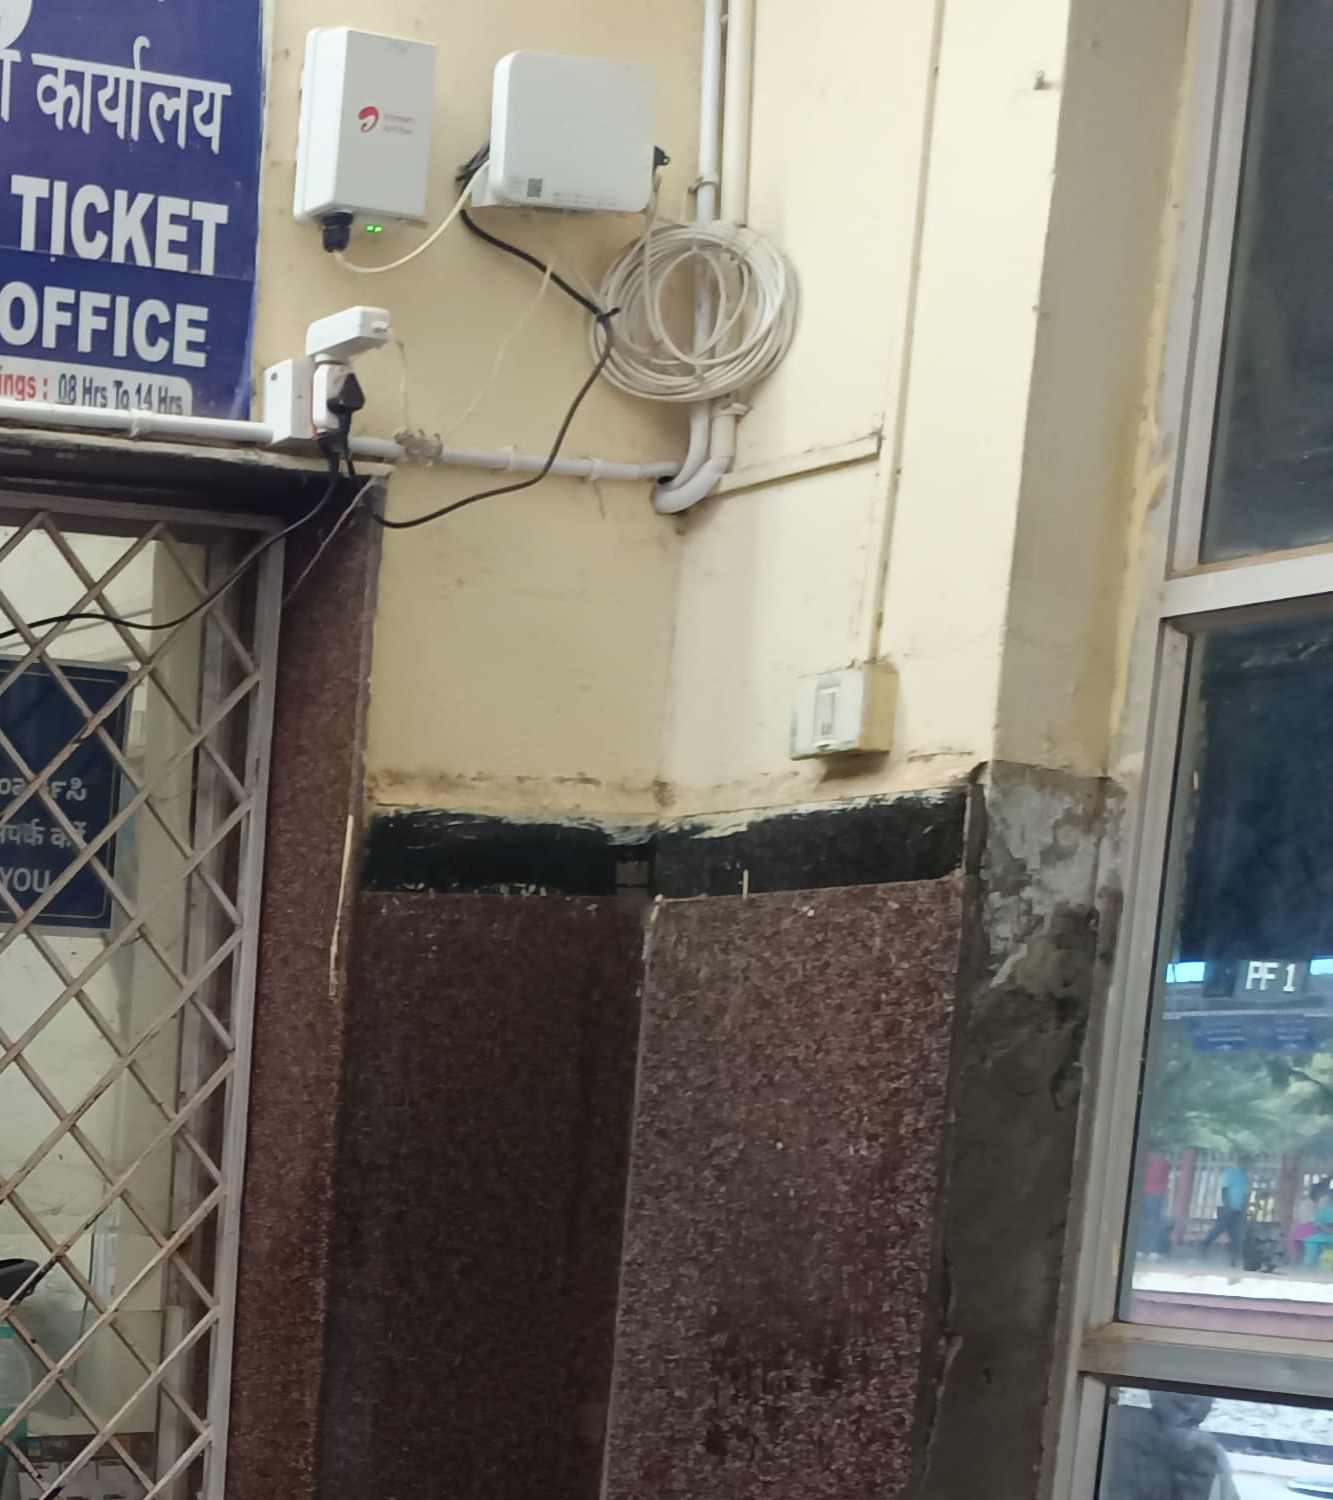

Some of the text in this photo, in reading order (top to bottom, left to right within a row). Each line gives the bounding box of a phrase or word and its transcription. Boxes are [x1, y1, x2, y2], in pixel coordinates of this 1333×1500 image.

[32, 36, 232, 154] कार्यालय
[11, 174, 228, 276] TICKET
[58, 371, 78, 406] 08
[82, 375, 108, 408] Hrs
[113, 380, 131, 410] To
[135, 383, 154, 412] 14
[158, 386, 184, 415] Hrs
[1245, 961, 1297, 992] PF 1
